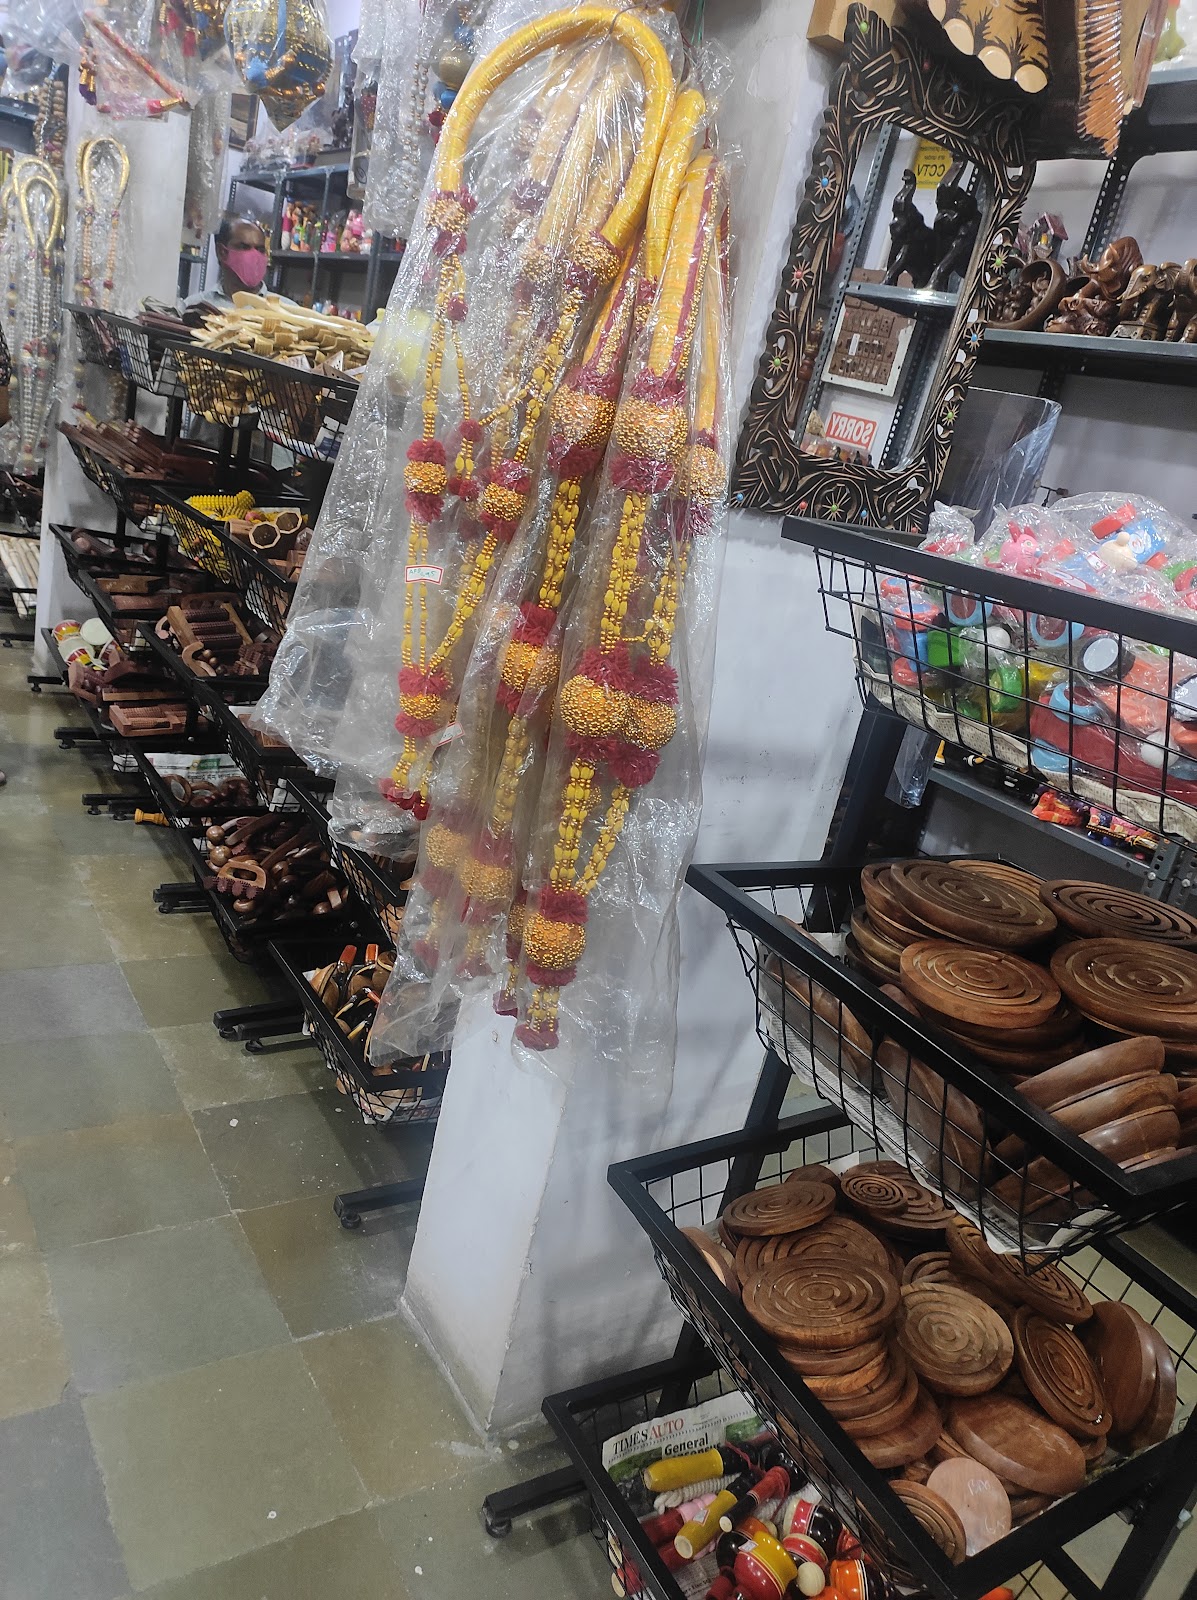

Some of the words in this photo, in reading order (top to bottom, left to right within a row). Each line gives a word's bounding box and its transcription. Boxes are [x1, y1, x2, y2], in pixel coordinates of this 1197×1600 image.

[613, 1429, 648, 1455] TIMES
[649, 1418, 684, 1439] AUTO
[664, 1433, 708, 1456] General
